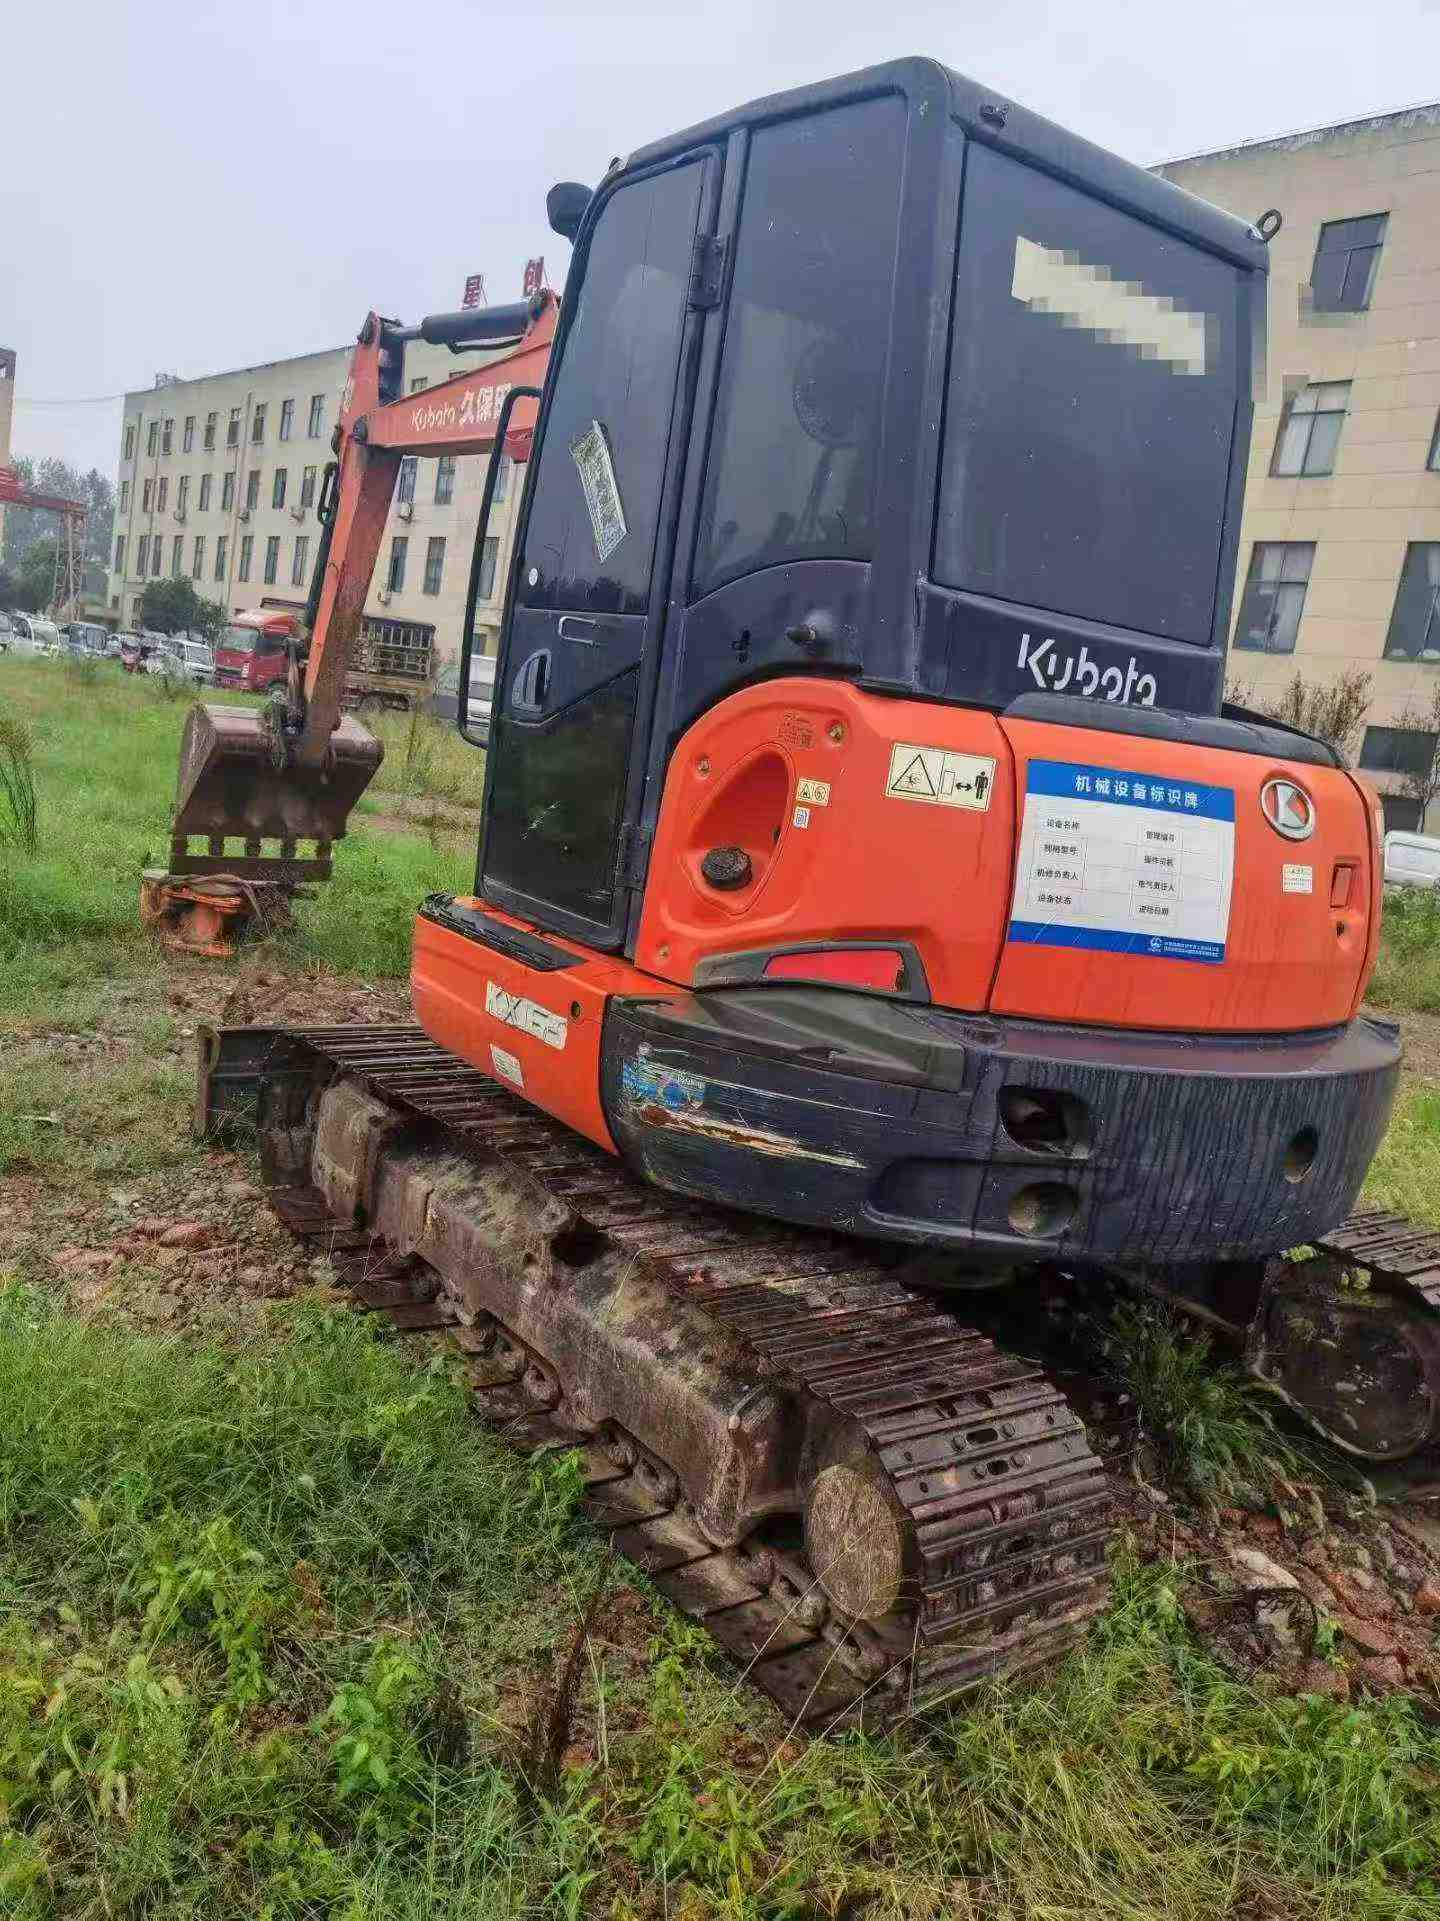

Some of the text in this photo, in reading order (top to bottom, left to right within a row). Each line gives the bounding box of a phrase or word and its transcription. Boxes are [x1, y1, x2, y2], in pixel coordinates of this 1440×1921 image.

[410, 402, 456, 431] Kubota
[1016, 633, 1157, 706] Kubota
[1074, 774, 1200, 809] 机械设备标识牌
[1046, 817, 1080, 831] 设备名称
